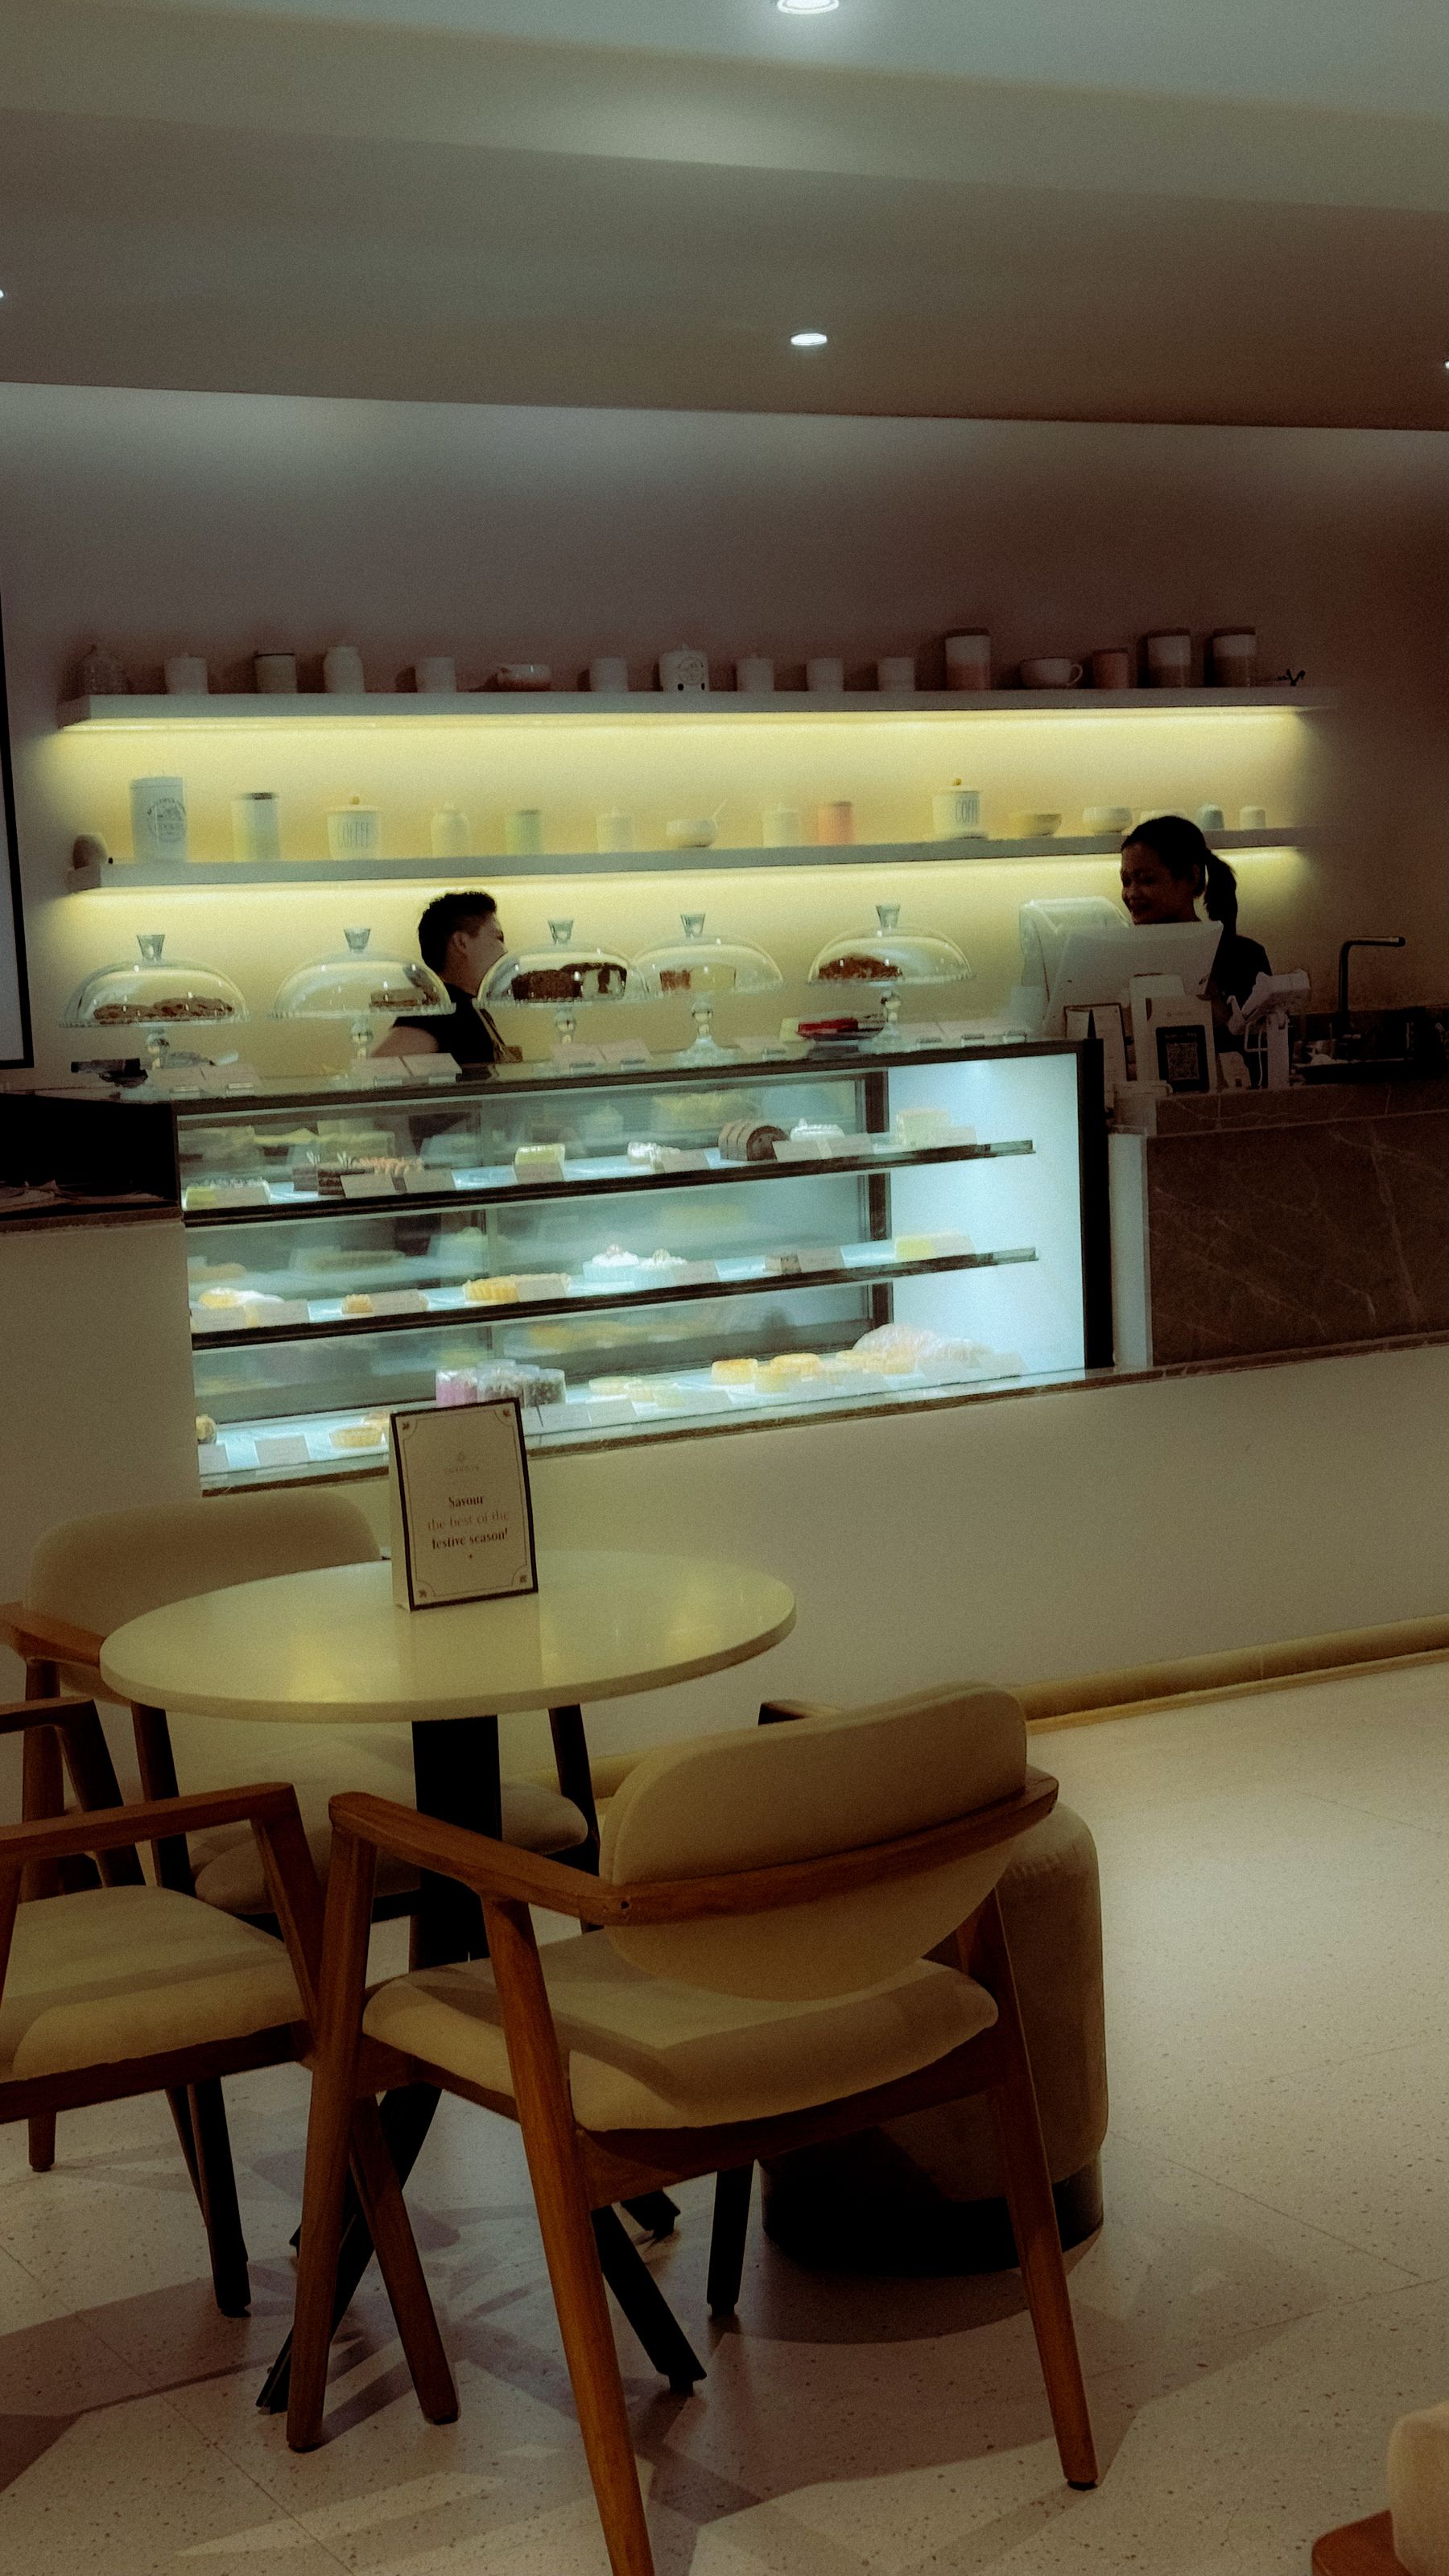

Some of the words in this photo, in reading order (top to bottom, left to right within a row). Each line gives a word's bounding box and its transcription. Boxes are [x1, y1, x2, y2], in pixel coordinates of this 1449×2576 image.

[337, 821, 371, 848] COFFEE
[448, 1496, 484, 1508] Savour
[427, 1519, 445, 1531] the
[449, 1516, 472, 1527] best
[477, 1513, 488, 1525] of
[492, 1510, 509, 1521] the
[432, 1537, 465, 1549] festive
[469, 1527, 508, 1544] season!
